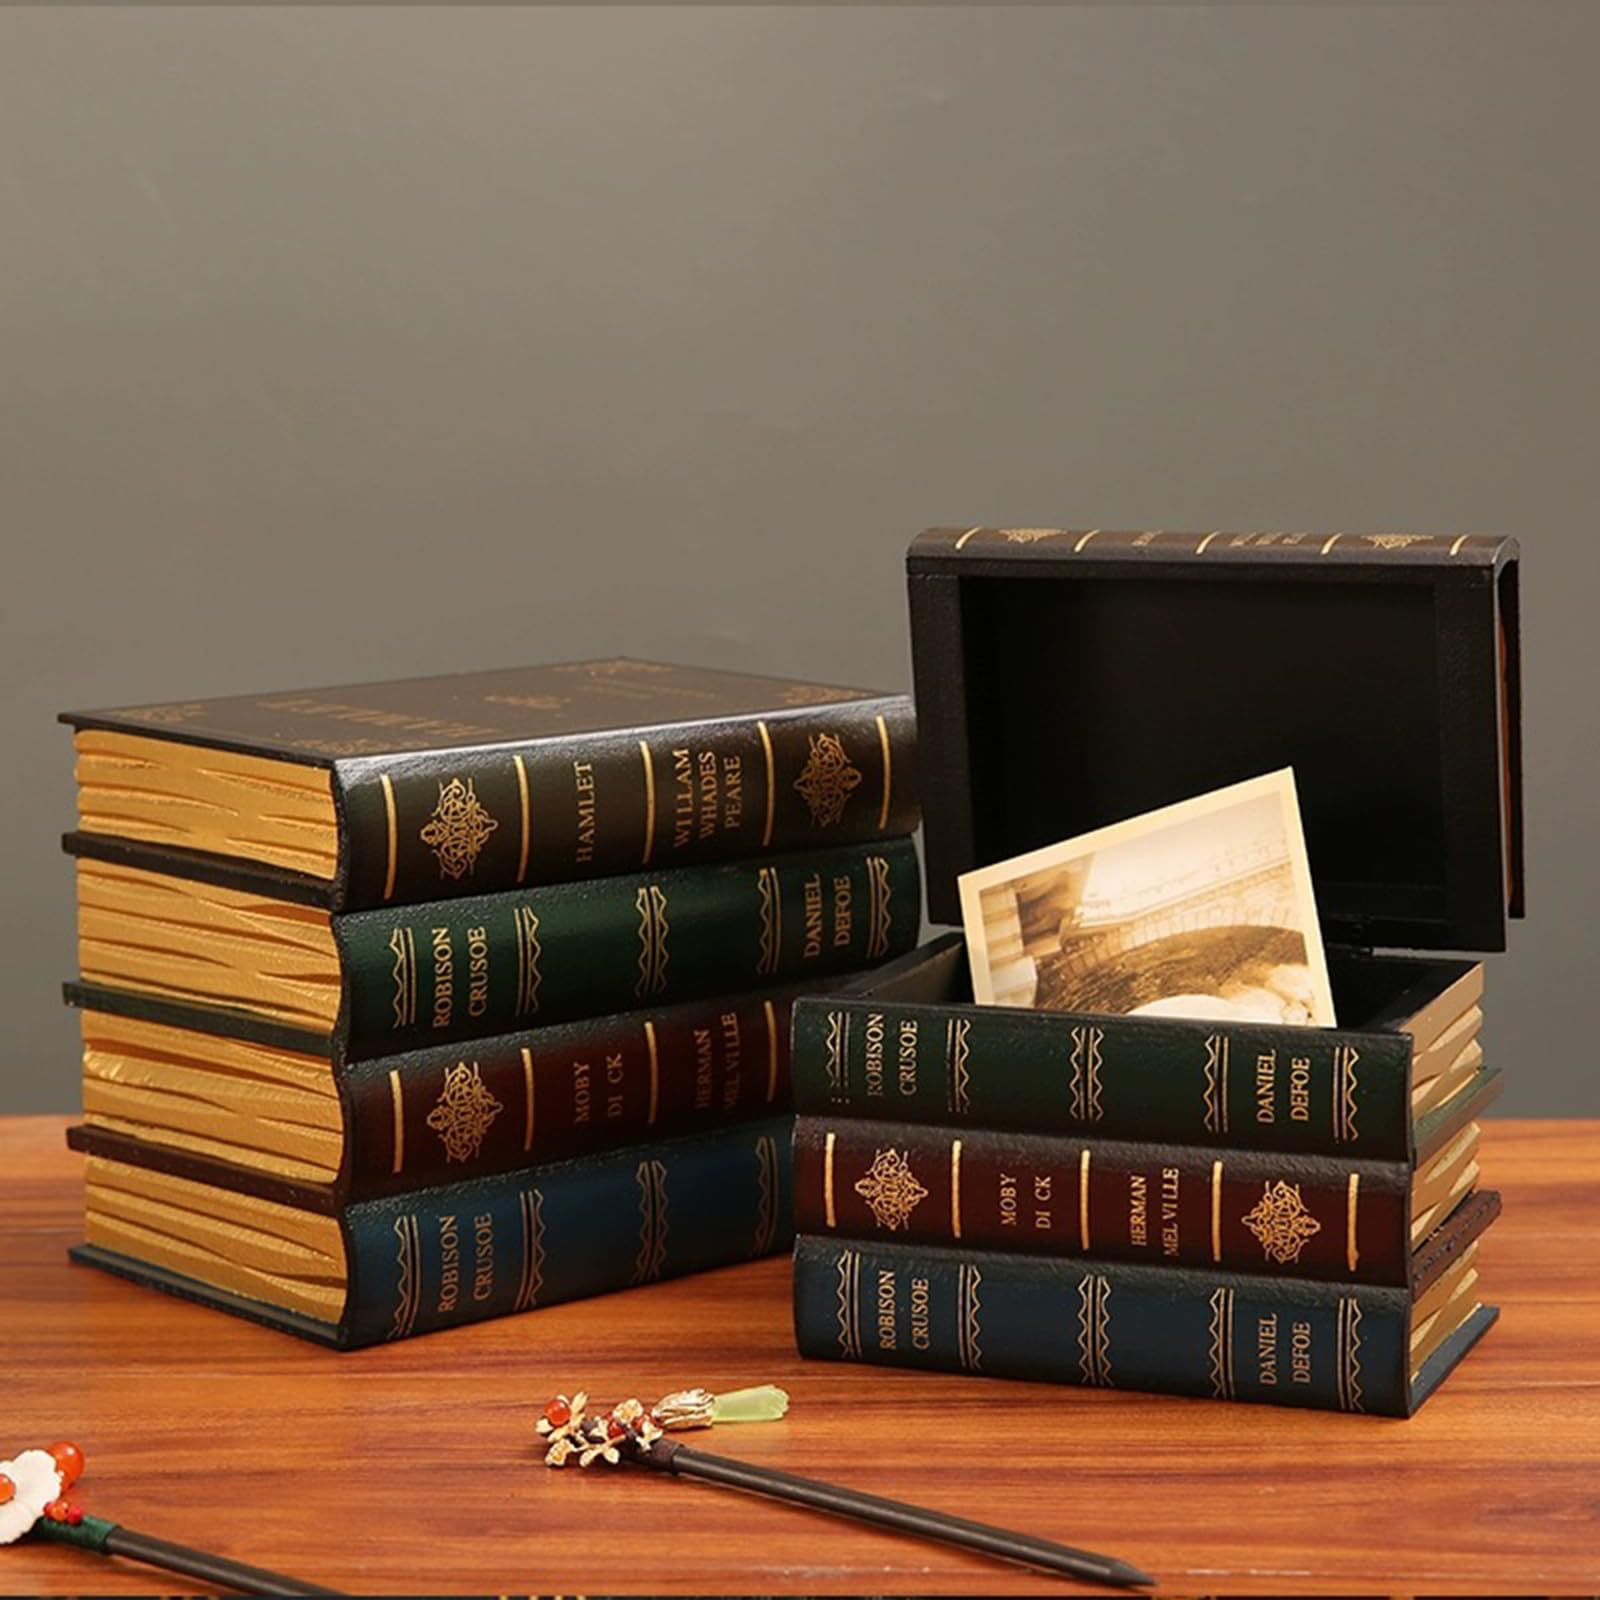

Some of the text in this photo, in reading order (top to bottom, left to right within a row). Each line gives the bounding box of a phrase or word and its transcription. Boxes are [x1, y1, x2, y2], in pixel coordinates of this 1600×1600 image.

[574, 760, 595, 863] HAMLET
[672, 748, 693, 848] WILLAM
[698, 751, 717, 839] WHADES
[723, 755, 742, 829] PEARE
[803, 873, 822, 958] DANIEL
[833, 875, 851, 947] DEFOE
[432, 927, 453, 1029] ROBISON
[467, 926, 488, 1017] CRUSOE
[573, 1061, 590, 1125] MOBY
[694, 1029, 713, 1110] HERMAN
[899, 1020, 918, 1096] CRUSOE
[1256, 1048, 1276, 1123] DANIEL
[1290, 1057, 1310, 1121] DEFOE
[1000, 1173, 1017, 1226] MOBY
[1129, 1175, 1147, 1246] HERMAN
[438, 1215, 459, 1313] ROBISON
[473, 1212, 494, 1301] CRUSOE
[878, 1269, 897, 1350] ROBISON
[911, 1278, 930, 1350] CRUSOE
[1259, 1312, 1277, 1385] DANIEL
[1292, 1321, 1311, 1383] DEFOE
